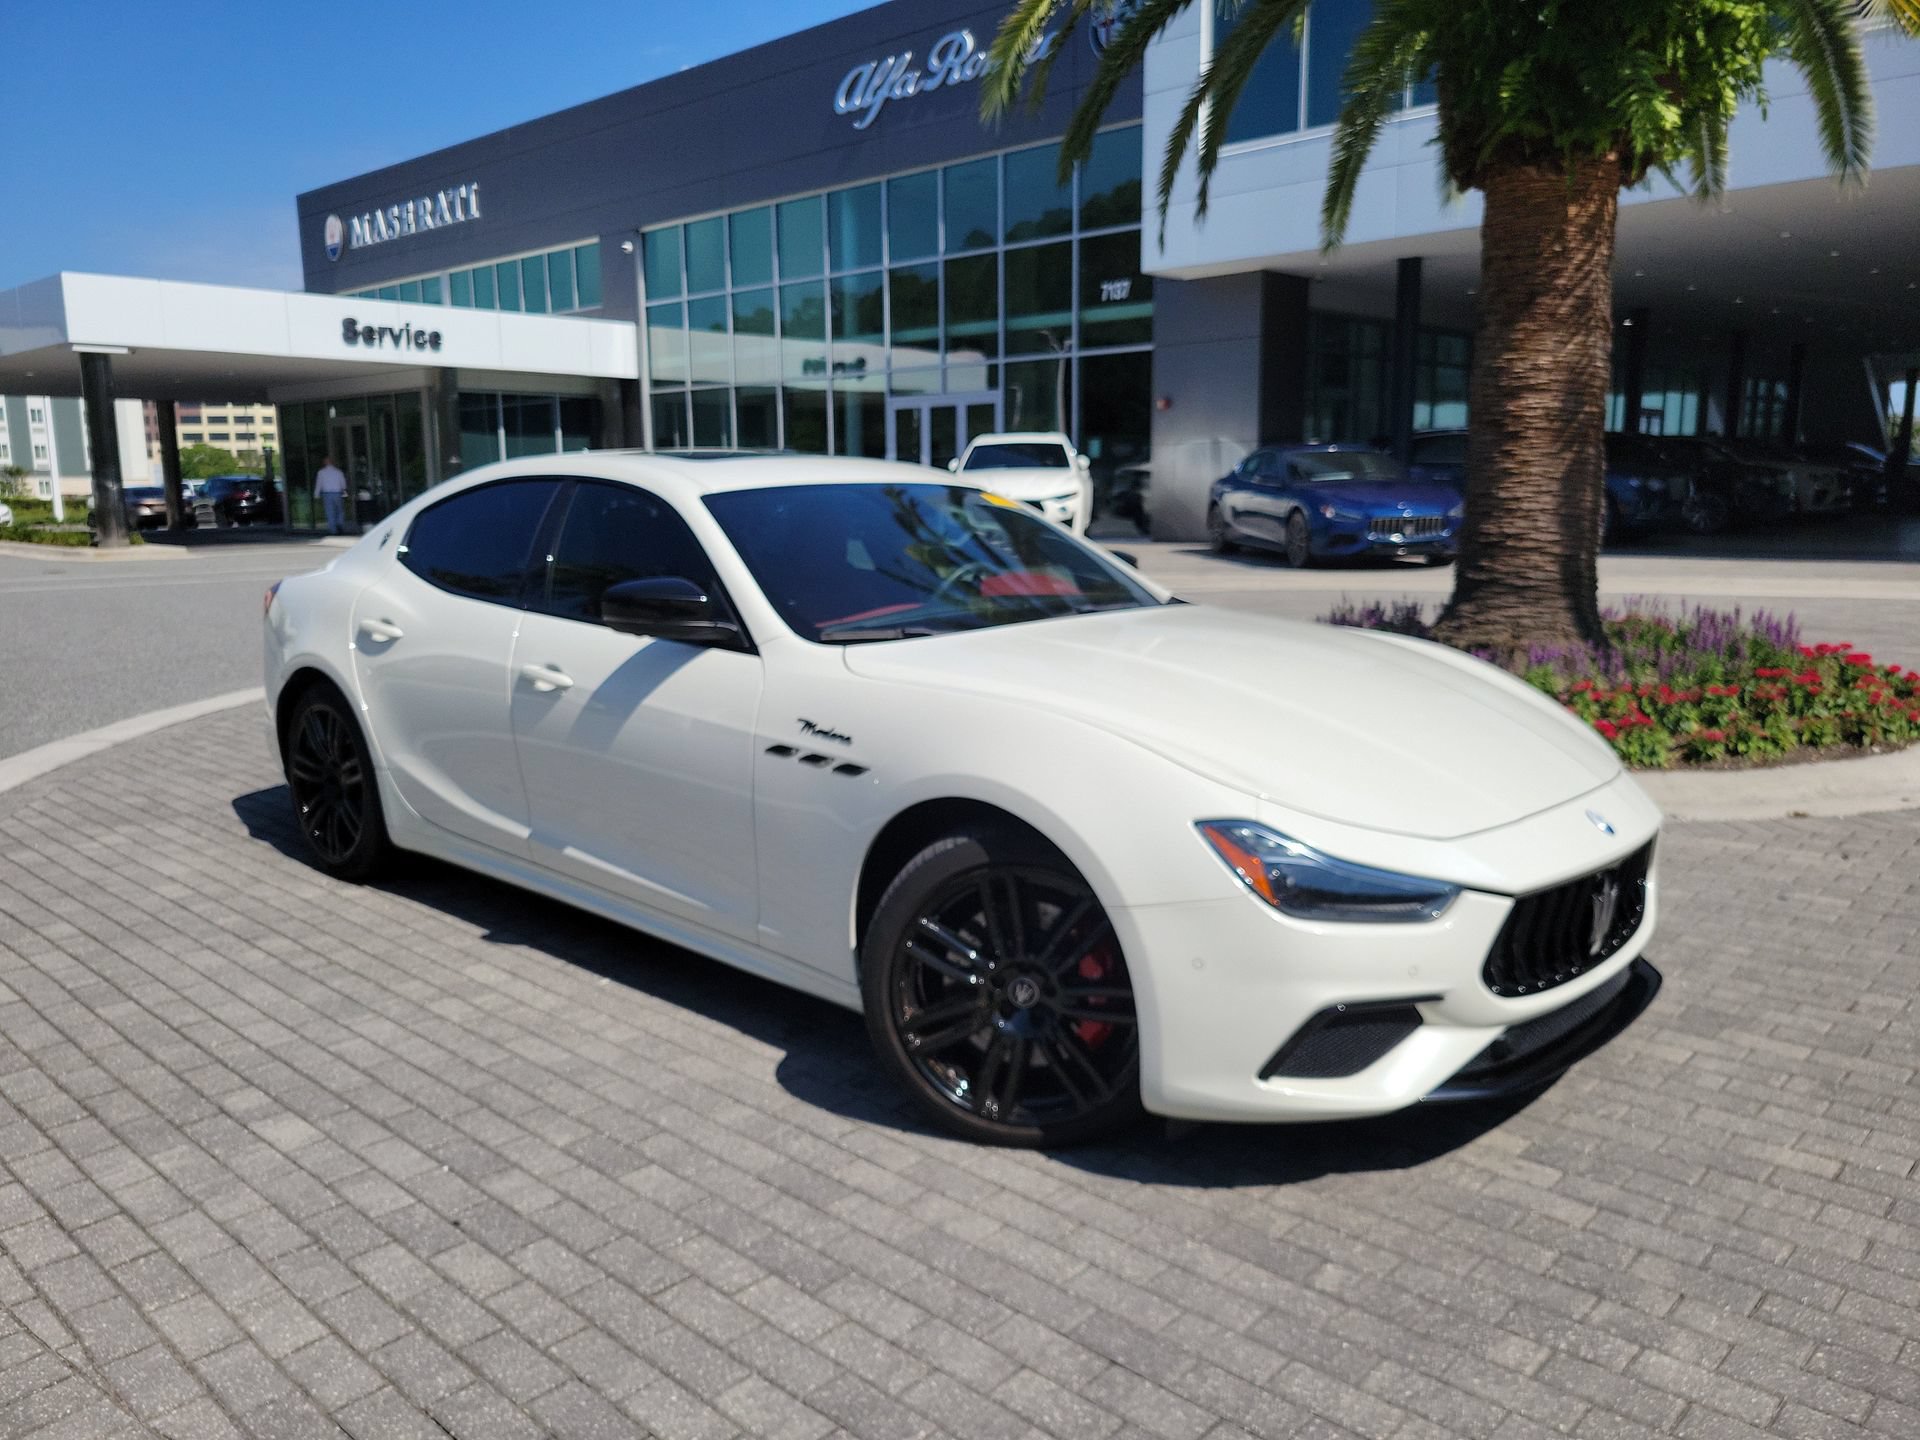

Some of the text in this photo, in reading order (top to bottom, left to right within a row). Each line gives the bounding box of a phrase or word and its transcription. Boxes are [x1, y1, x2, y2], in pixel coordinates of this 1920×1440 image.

[834, 50, 922, 130] Alfa
[350, 181, 480, 250] MASERATI
[341, 316, 443, 353] Service
